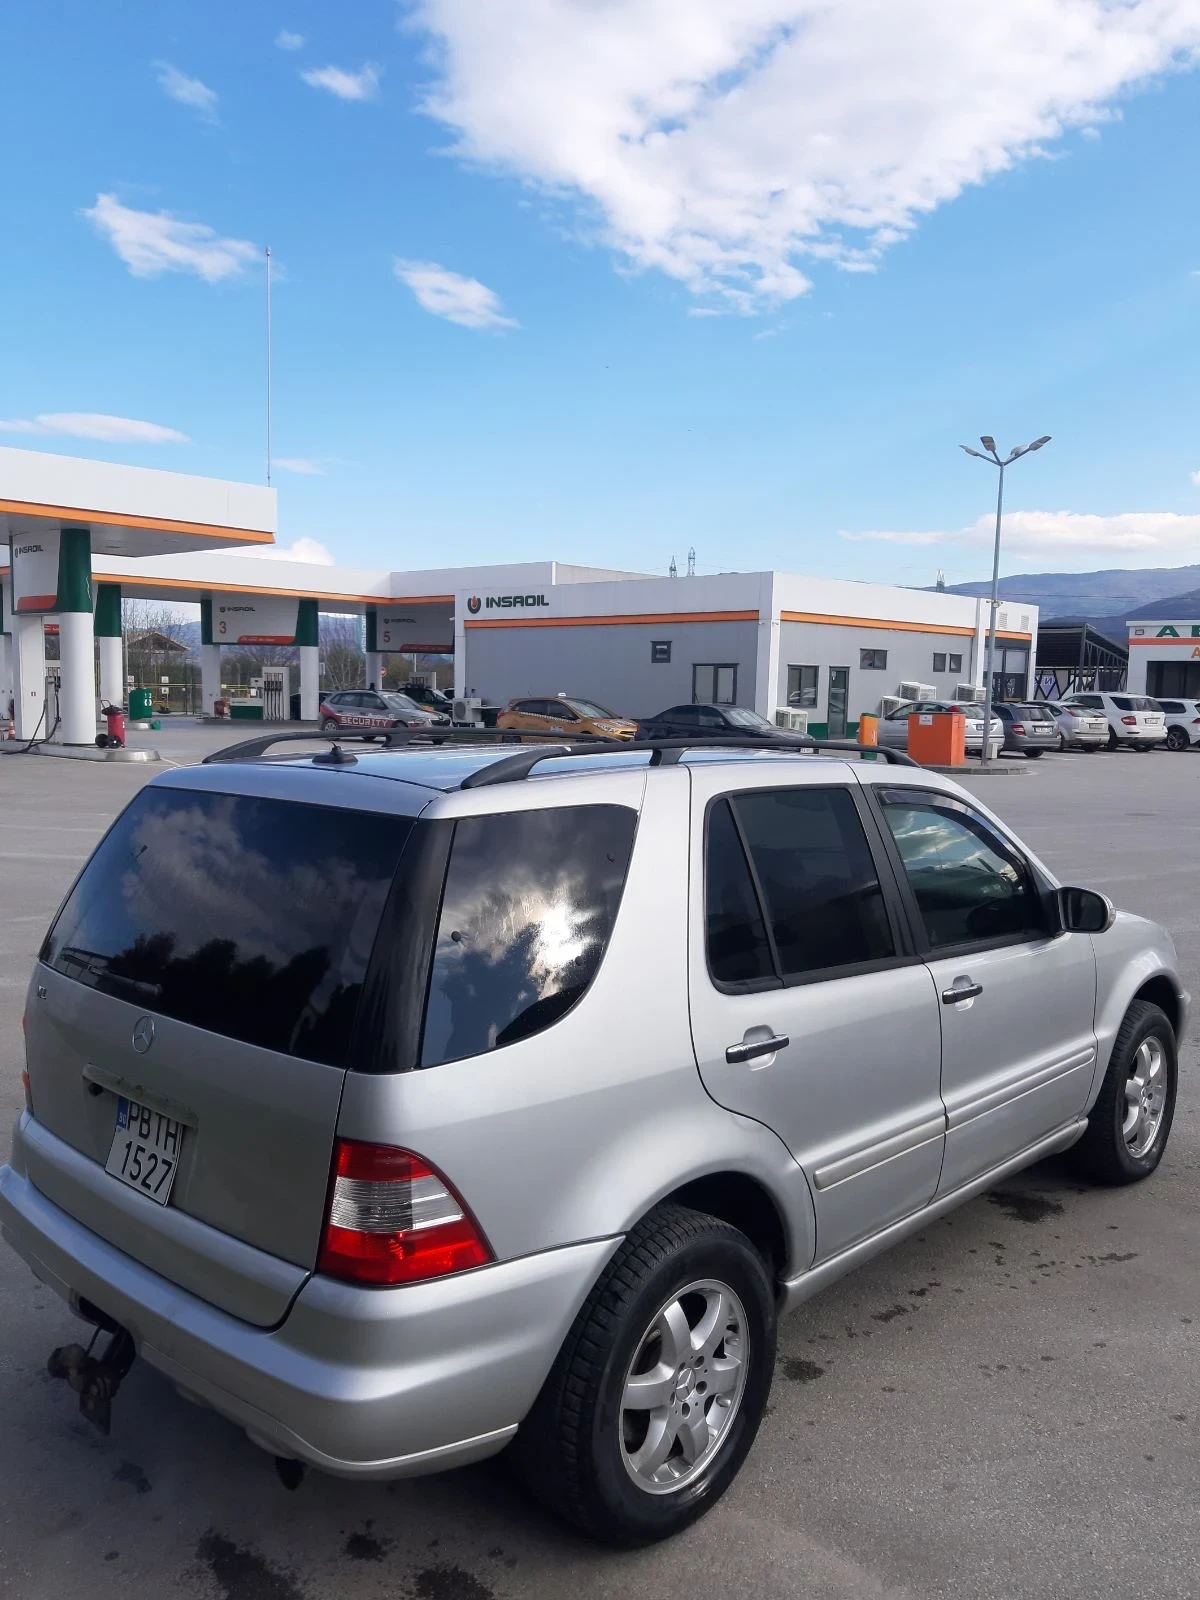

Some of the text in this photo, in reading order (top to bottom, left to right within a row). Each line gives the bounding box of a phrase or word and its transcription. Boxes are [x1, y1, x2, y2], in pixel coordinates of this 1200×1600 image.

[485, 594, 550, 608] INSAOIL
[219, 621, 227, 634] 3
[383, 631, 391, 643] 5
[340, 716, 389, 727] SECURITY
[121, 1140, 173, 1194] 1527
